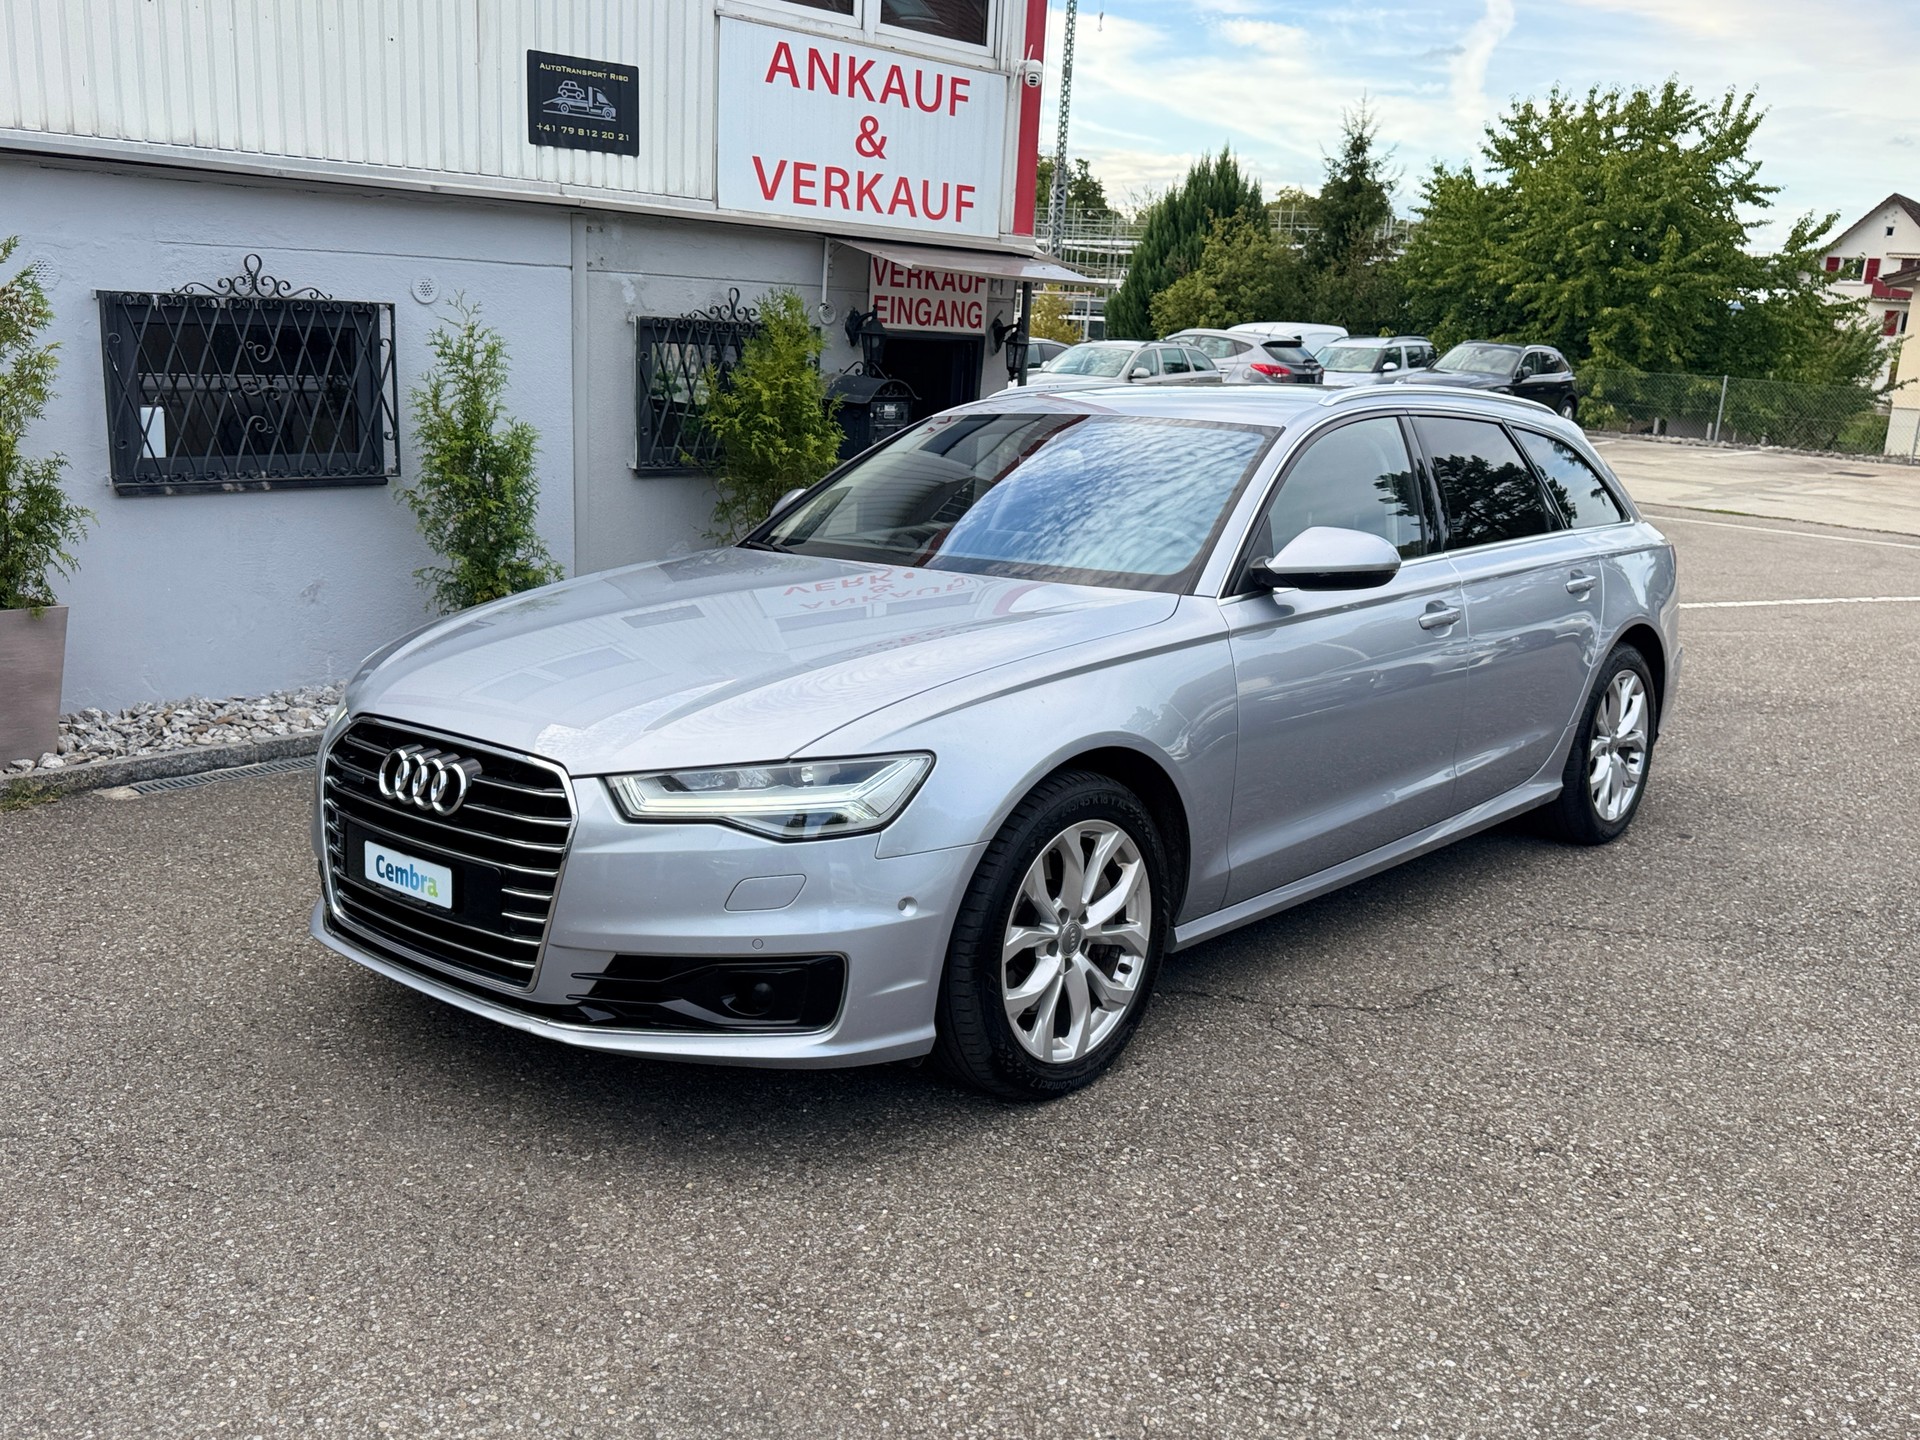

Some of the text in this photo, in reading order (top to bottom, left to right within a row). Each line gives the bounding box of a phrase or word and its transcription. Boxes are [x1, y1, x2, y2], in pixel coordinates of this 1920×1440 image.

[765, 41, 970, 117] ANKAUF
[536, 122, 630, 141] +41 79 812 20 21
[855, 115, 887, 160] &
[752, 155, 975, 222] VERKAUF
[873, 295, 983, 329] EINGANG
[376, 854, 438, 897] Cembra
